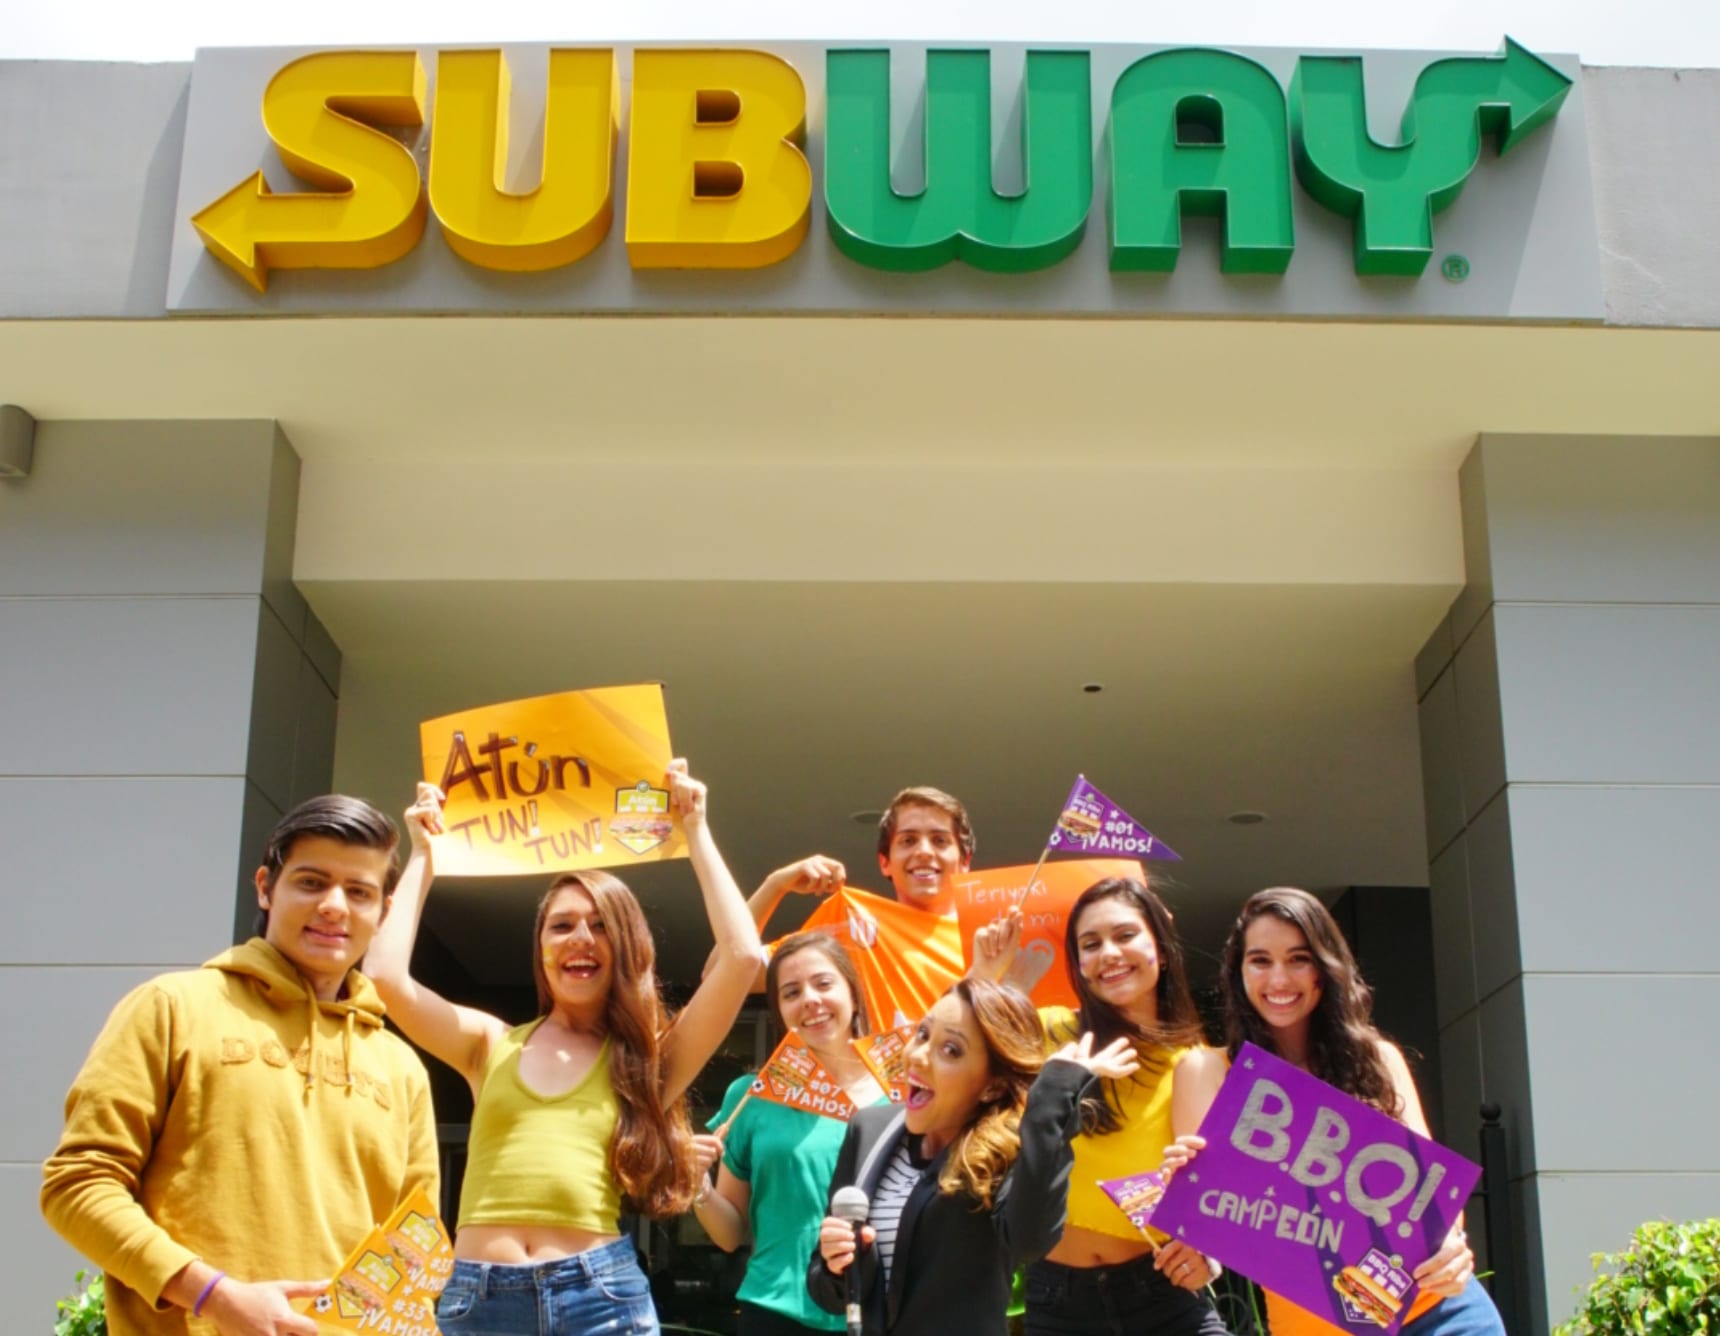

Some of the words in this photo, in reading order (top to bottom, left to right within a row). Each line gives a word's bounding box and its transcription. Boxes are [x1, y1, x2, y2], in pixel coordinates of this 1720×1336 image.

[190, 35, 1574, 290] SUBWAY
[440, 730, 591, 811] Atún
[450, 800, 541, 850] TUN!
[524, 817, 603, 865] TUN!
[1081, 831, 1153, 854] ¡VAMOS!
[783, 1086, 855, 1118] ¡VAMOS!
[1229, 1077, 1447, 1239] B.B.Q!
